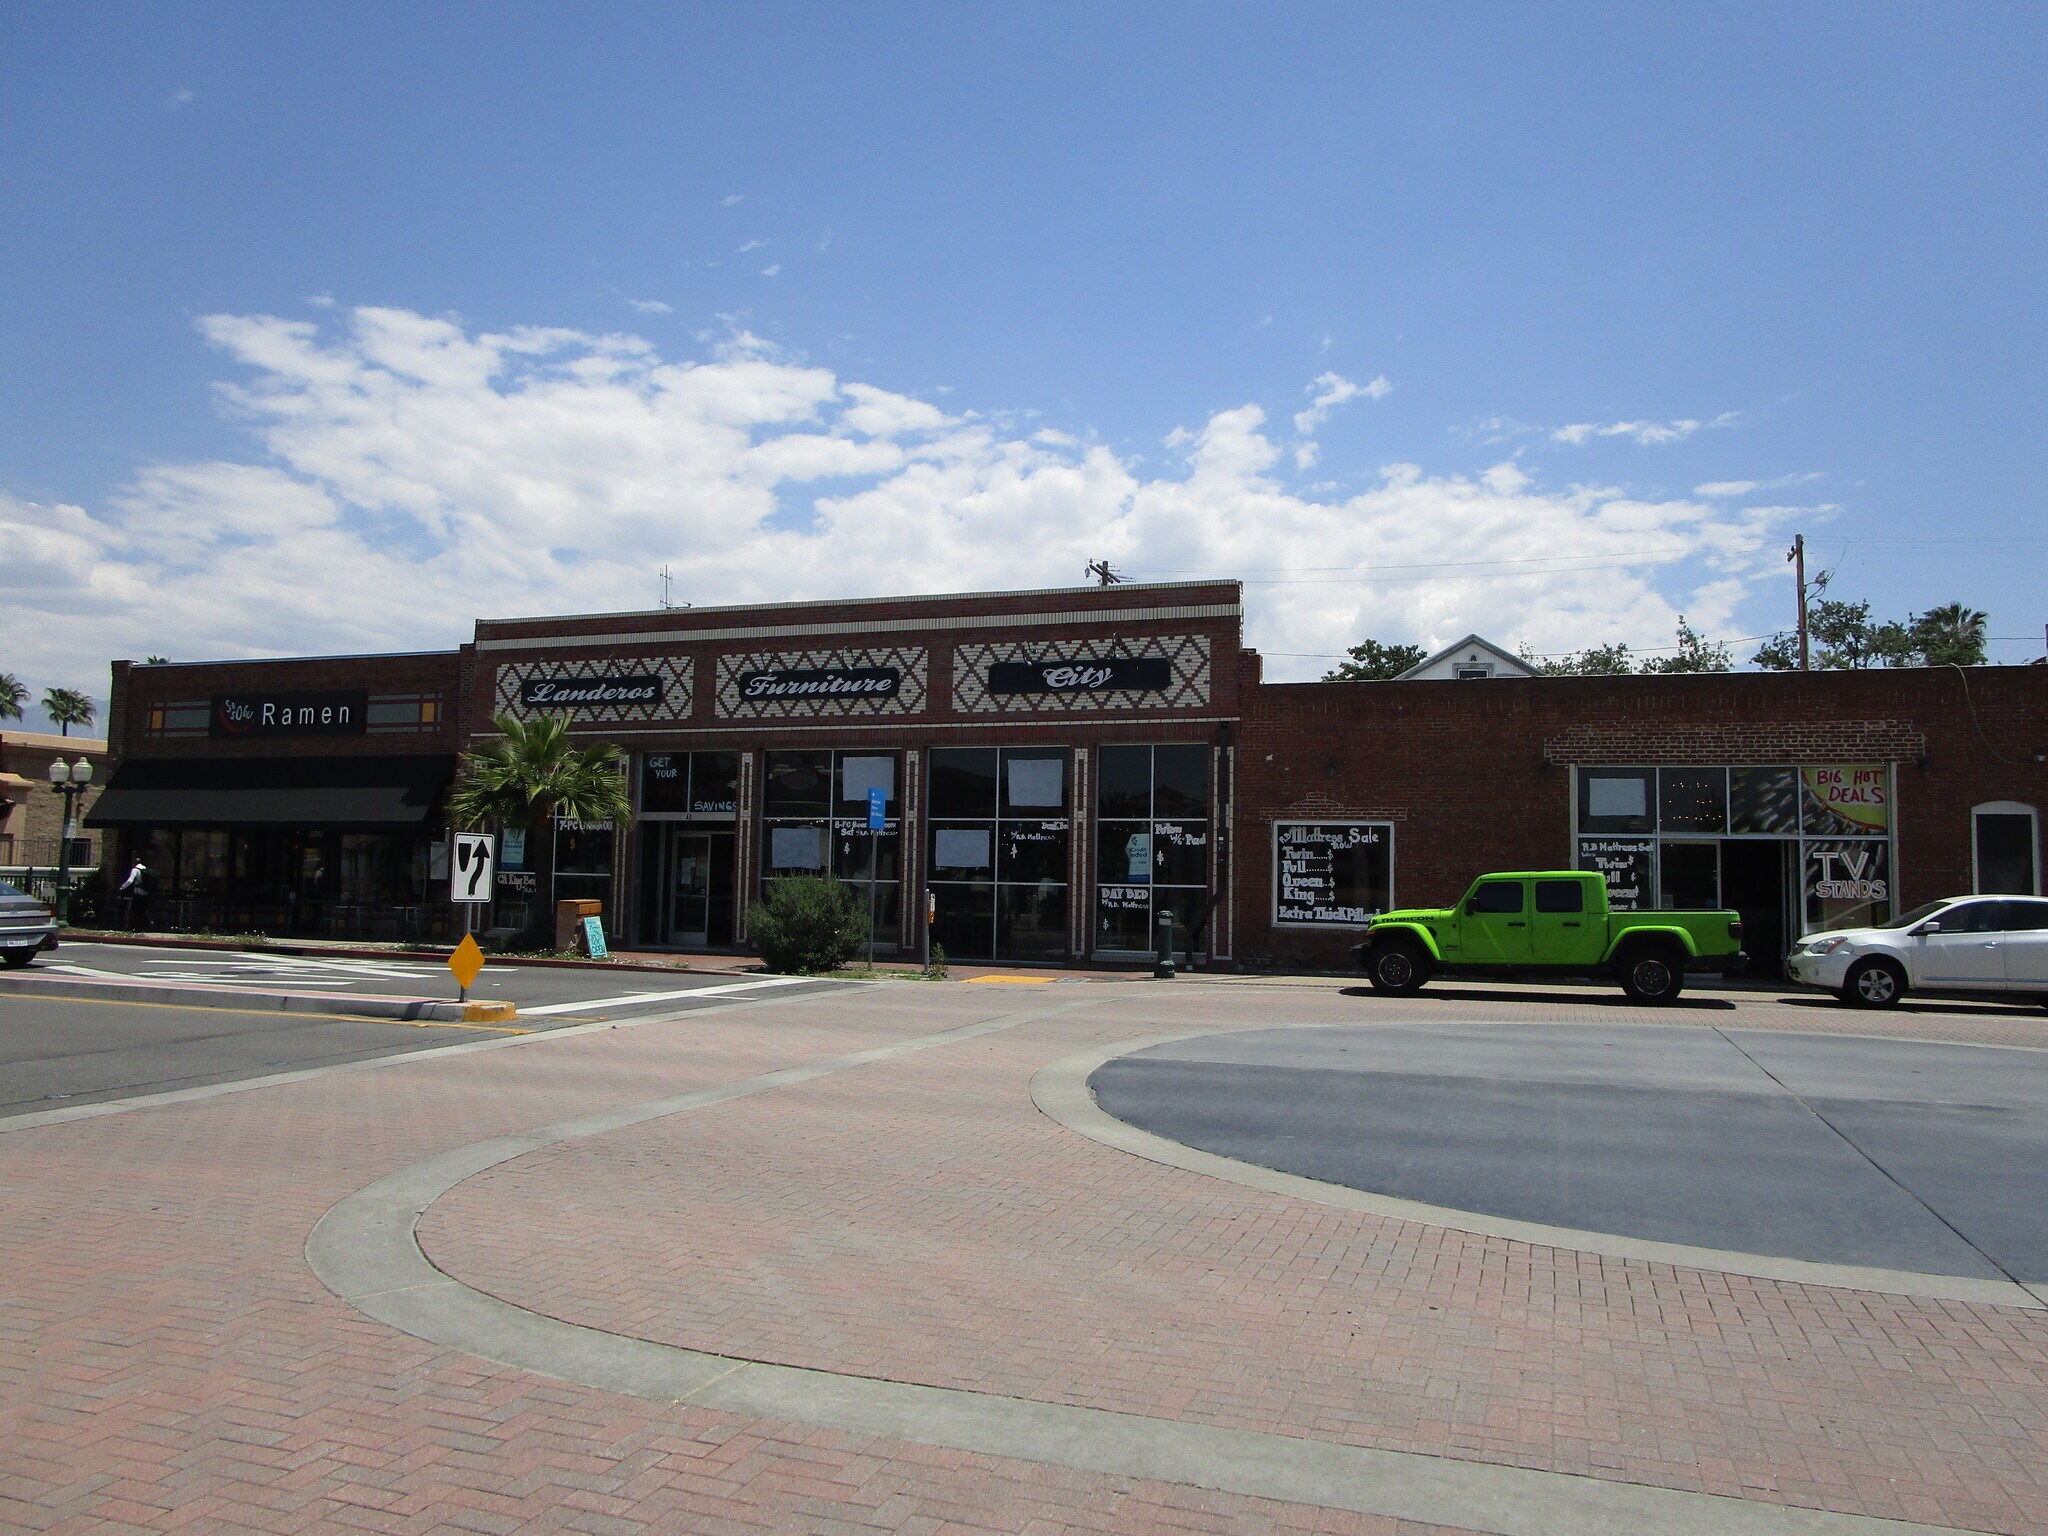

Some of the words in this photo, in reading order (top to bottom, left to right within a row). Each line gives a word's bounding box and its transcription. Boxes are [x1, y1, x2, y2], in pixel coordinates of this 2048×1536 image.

[1043, 666, 1113, 688] City
[527, 683, 655, 702] Landeros
[745, 675, 892, 696] Furniture
[262, 703, 350, 725] Ramen
[650, 757, 670, 768] GET
[655, 769, 677, 779] YOUR
[1817, 770, 1842, 785] BIG
[1853, 770, 1884, 785] HOT
[1829, 787, 1884, 803] DEALS
[1185, 833, 1207, 846] Pad
[1289, 827, 1344, 844] Mattress
[1348, 827, 1379, 844] Sale
[1600, 842, 1637, 852] Mattress
[1813, 851, 1869, 881] TV
[1101, 888, 1124, 899] DAY
[1126, 888, 1149, 900] BED
[1283, 887, 1315, 906] King
[1816, 879, 1887, 899] STANDS
[1279, 906, 1313, 920] Extra
